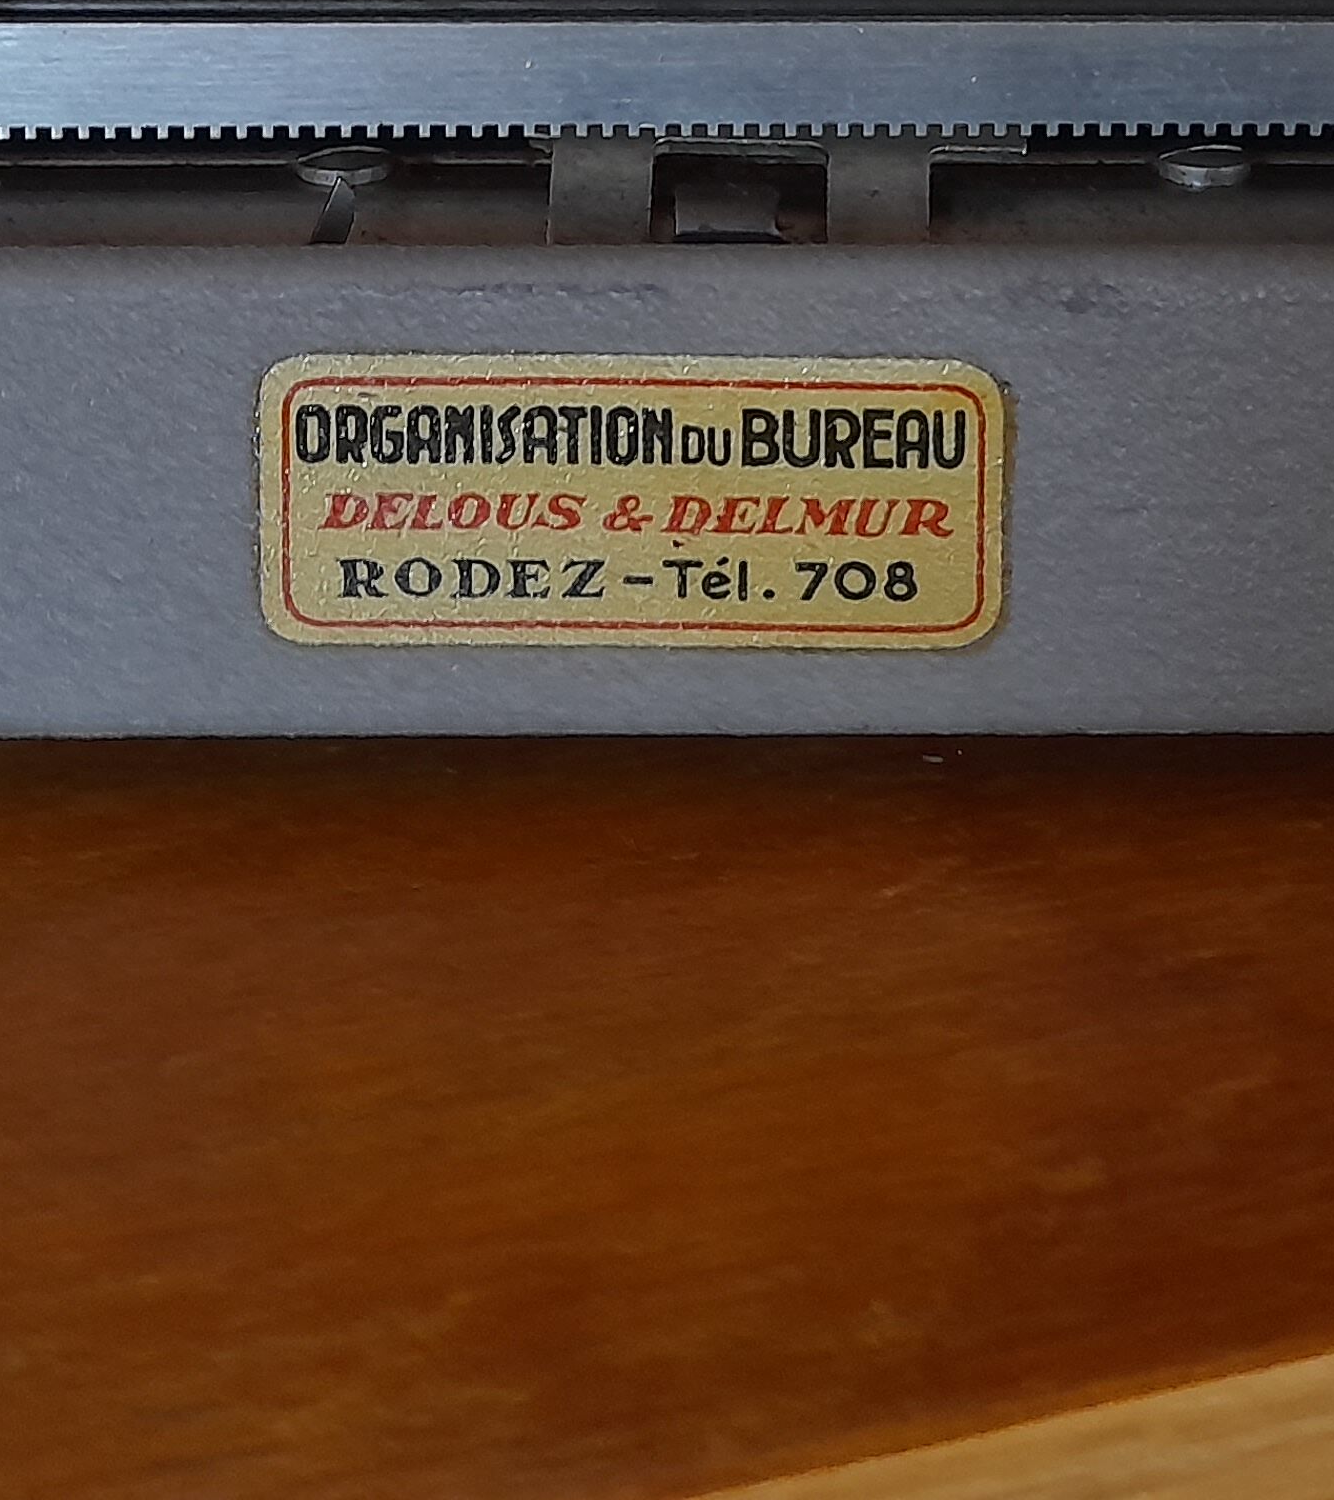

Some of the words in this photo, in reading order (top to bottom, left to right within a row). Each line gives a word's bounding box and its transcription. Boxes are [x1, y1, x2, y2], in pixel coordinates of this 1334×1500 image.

[295, 403, 674, 467] ORGANISATION
[682, 424, 733, 466] DU
[742, 409, 967, 470] BUREAU
[318, 492, 589, 531] DELOUS
[602, 496, 655, 532] &
[661, 494, 956, 538] DELMUR
[337, 556, 607, 600] RODEZ
[663, 554, 777, 602] Tél.
[796, 560, 919, 603] 708
